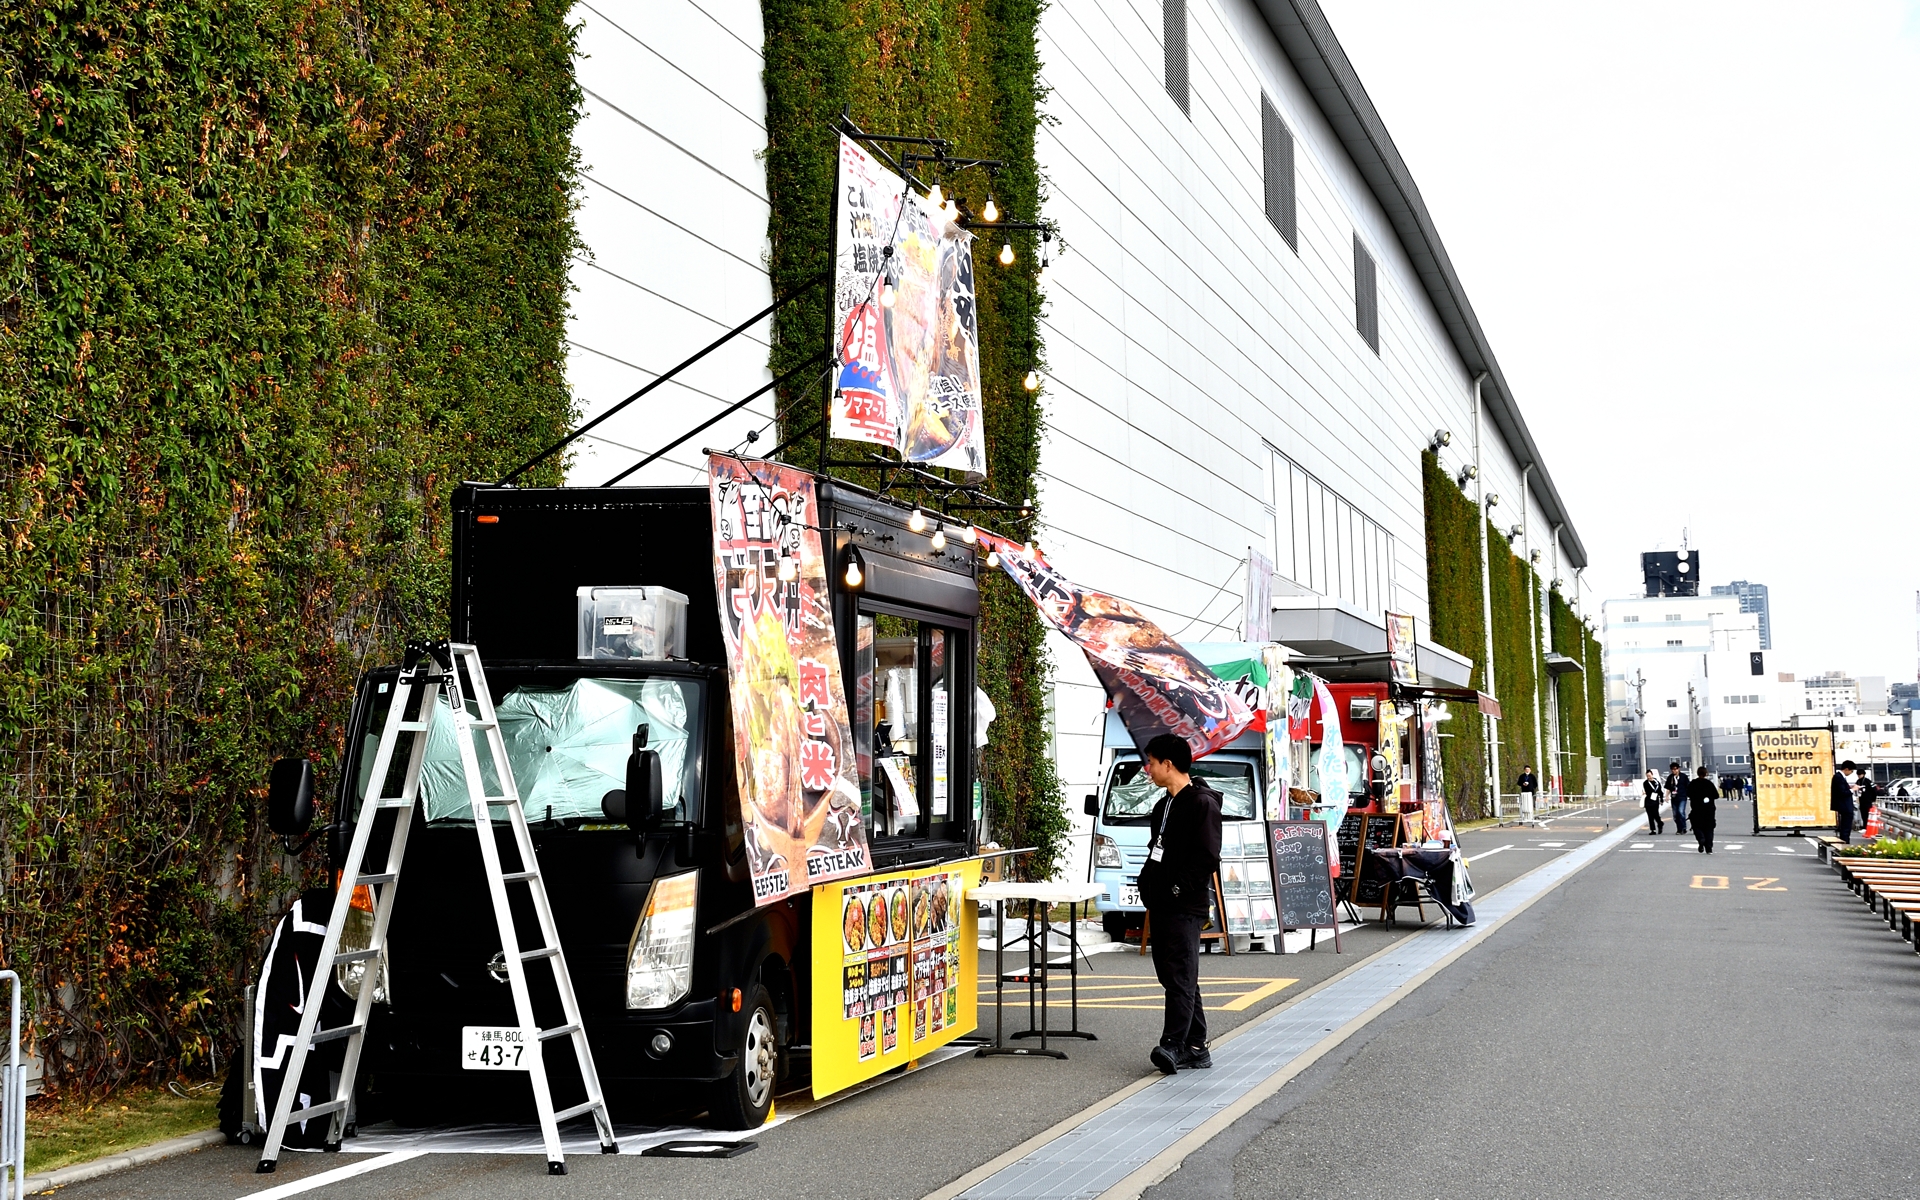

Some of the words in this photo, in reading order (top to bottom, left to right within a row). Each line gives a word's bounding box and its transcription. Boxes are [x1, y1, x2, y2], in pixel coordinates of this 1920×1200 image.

[847, 309, 881, 371] 塩
[799, 661, 833, 787] 肉と米
[1756, 733, 1819, 749] Mobility
[1757, 749, 1814, 761] Culture
[1758, 763, 1823, 778] Program
[481, 1031, 503, 1042] 練馬
